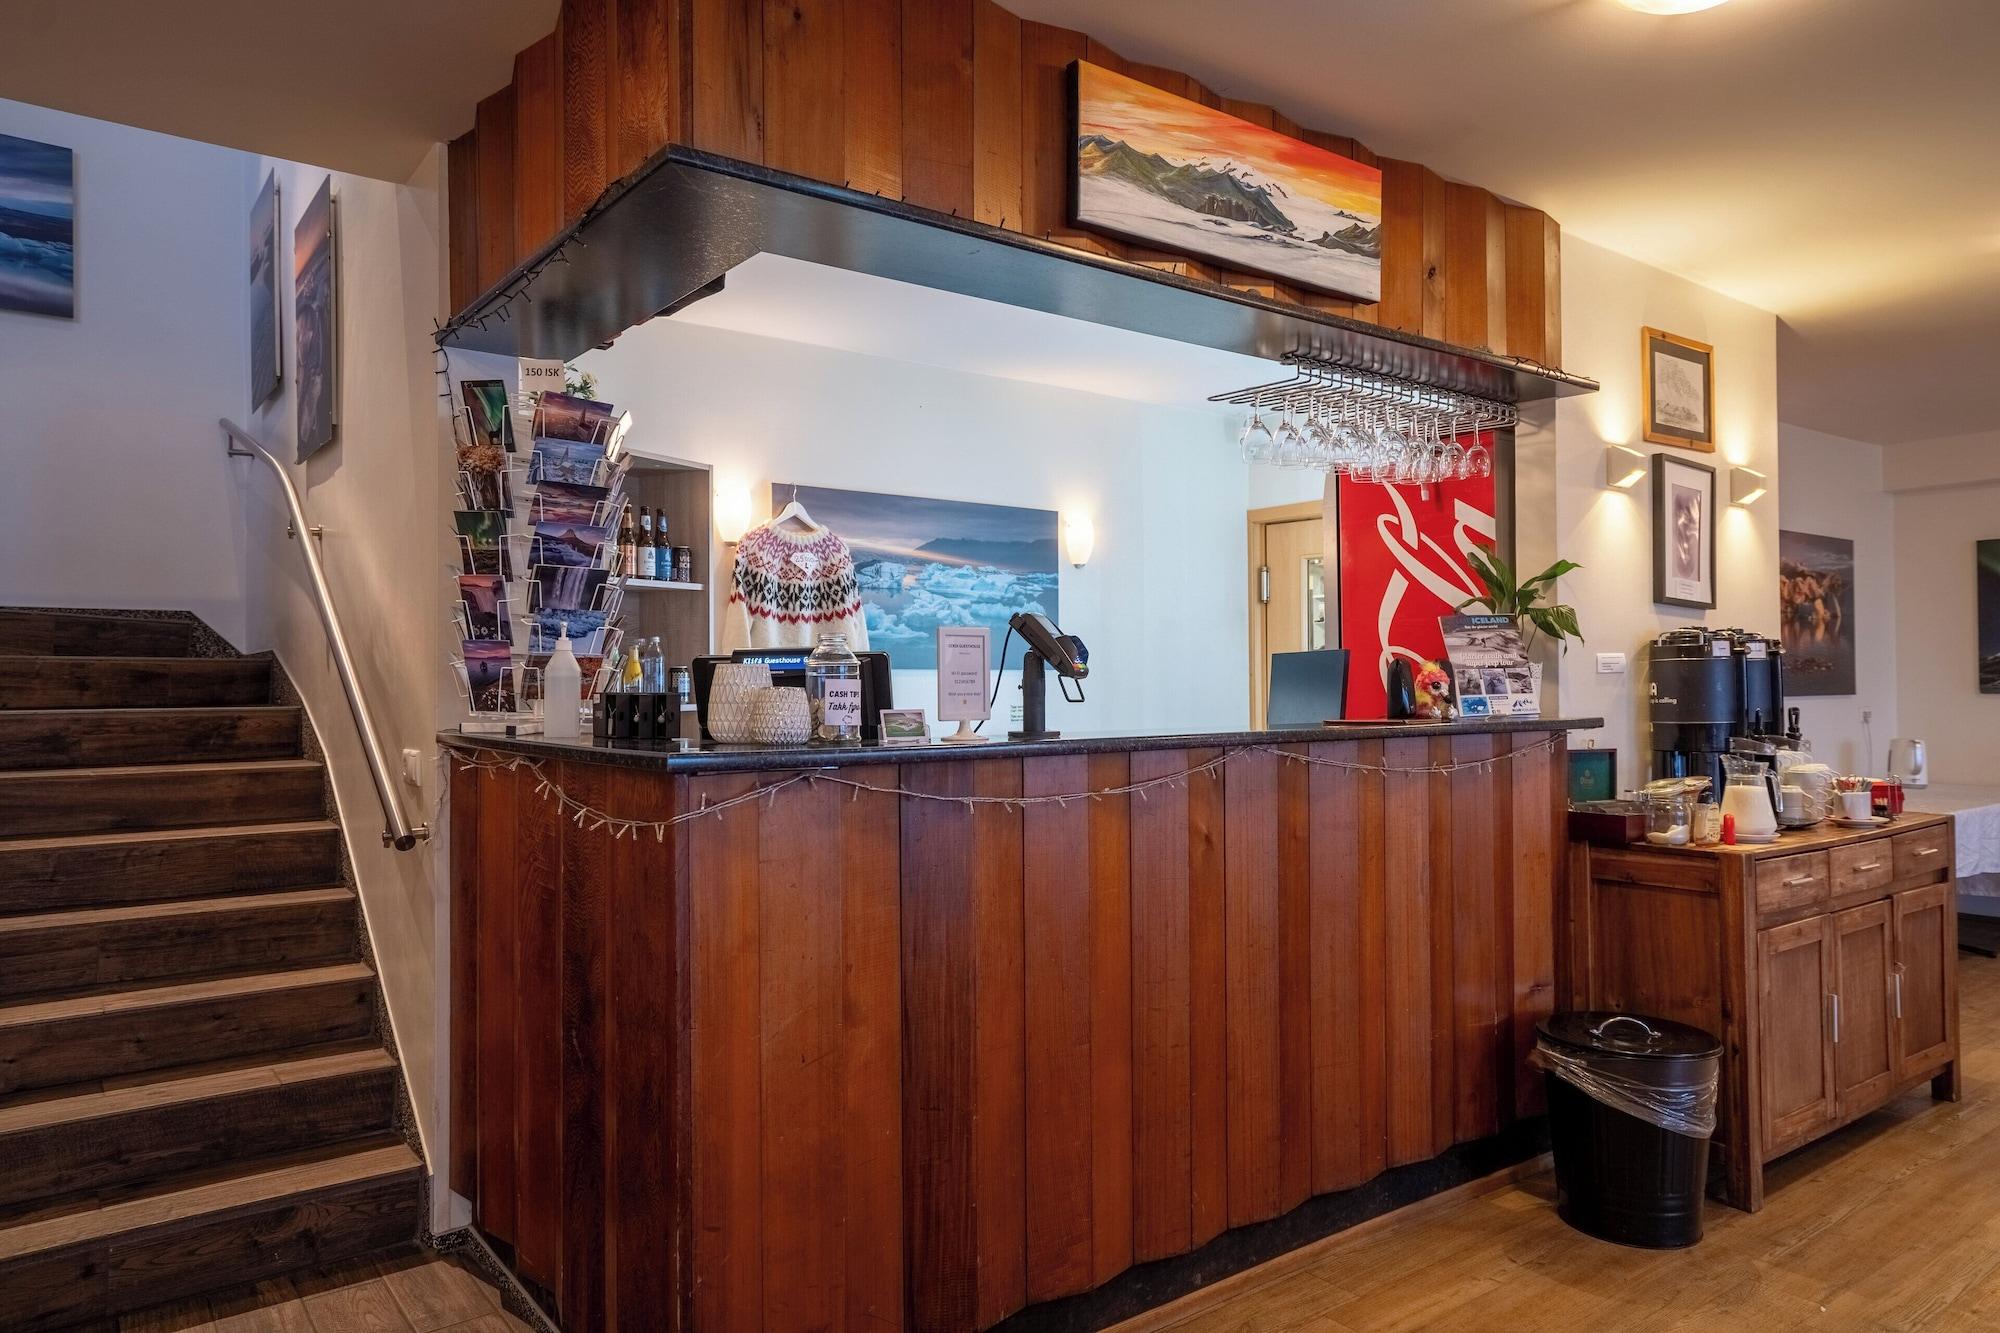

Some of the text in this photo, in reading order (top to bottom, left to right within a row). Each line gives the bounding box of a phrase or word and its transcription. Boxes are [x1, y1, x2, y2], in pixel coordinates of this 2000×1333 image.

[525, 367, 560, 377] 150 ISK
[1471, 616, 1510, 624] ICELAND
[764, 656, 801, 664] Guesthouse
[829, 690, 848, 698] CASH
[1659, 697, 1678, 705] calling
[828, 701, 848, 711] Takk
